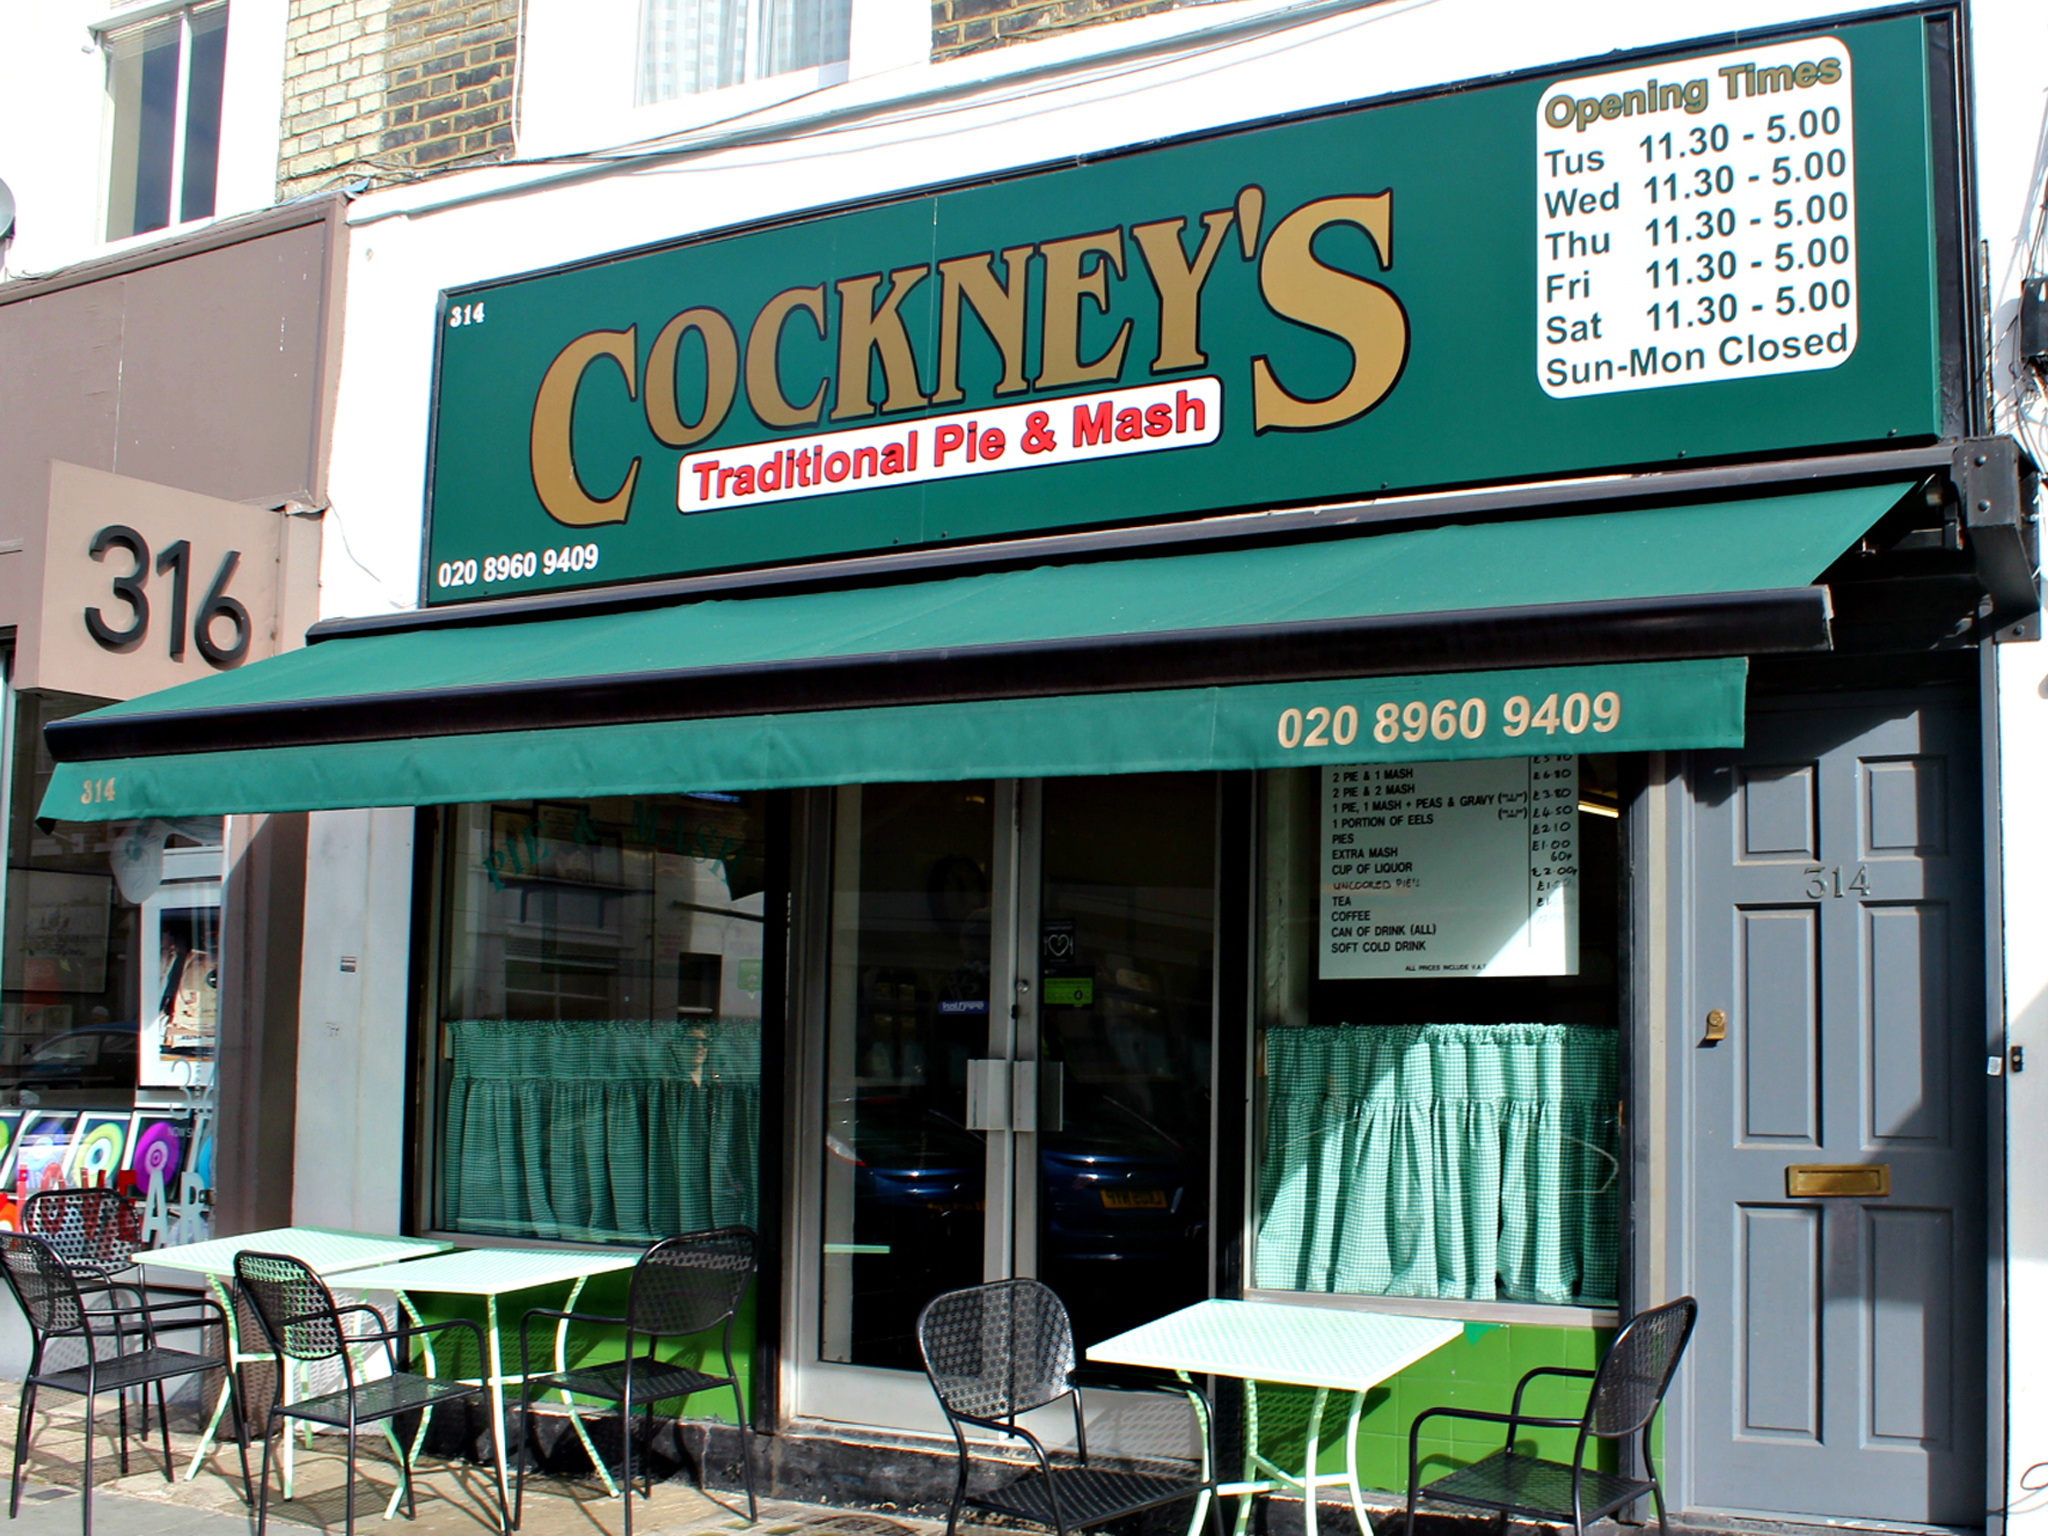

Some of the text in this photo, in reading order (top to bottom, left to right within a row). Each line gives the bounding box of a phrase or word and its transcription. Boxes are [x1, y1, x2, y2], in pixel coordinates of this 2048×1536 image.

[1545, 57, 1842, 132] Opening Times
[1544, 149, 1605, 177] Tus
[1639, 124, 1729, 163] 11.30
[1766, 106, 1841, 143] 5.00
[1544, 182, 1620, 219] Wed
[1644, 165, 1734, 204] 11.30
[1772, 148, 1846, 185] 5.00
[1545, 231, 1610, 260] Thu
[1645, 208, 1735, 246] 11.30
[1773, 191, 1848, 228] 5.00
[1547, 270, 1590, 303] Fri
[1646, 250, 1736, 289] 11.30
[1774, 235, 1849, 272] 5.00
[449, 302, 485, 328] 314
[1546, 312, 1602, 344] Sat
[1647, 293, 1737, 332] 11.30
[1775, 279, 1850, 315] 5.00
[529, 184, 1411, 528] COCKNEY'S
[1546, 323, 1847, 387] Sun-Mon Closed
[692, 390, 1206, 503] Traditional Pie & Mash
[437, 543, 599, 589] 020 8960 9409
[84, 524, 252, 670] 316
[1277, 691, 1621, 749] 020 8960 9409
[80, 777, 116, 804] 314
[1332, 769, 1414, 782] 2 PIE & 1 MASH
[1332, 784, 1415, 798] 2 PIE & 2 MASH
[1333, 804, 1338, 813] 1
[1372, 800, 1402, 811] MASH
[1415, 798, 1443, 809] PEAS
[1447, 797, 1454, 807] &
[1460, 794, 1495, 806] GRAVY
[1333, 814, 1434, 829] 1 PORTION OF EELS
[482, 799, 748, 893] PIE & MASH
[1332, 833, 1355, 844] PIES
[1332, 847, 1398, 860] EXTRA MASH
[1331, 861, 1413, 875] CUP OF LIQUOR
[1804, 864, 1871, 900] 314
[1331, 910, 1371, 921] COFFEE
[1332, 896, 1352, 906] TEA
[1331, 923, 1437, 938] CAN OF DRINK (ALL)
[1331, 940, 1427, 954] SOFT COLD DRINK
